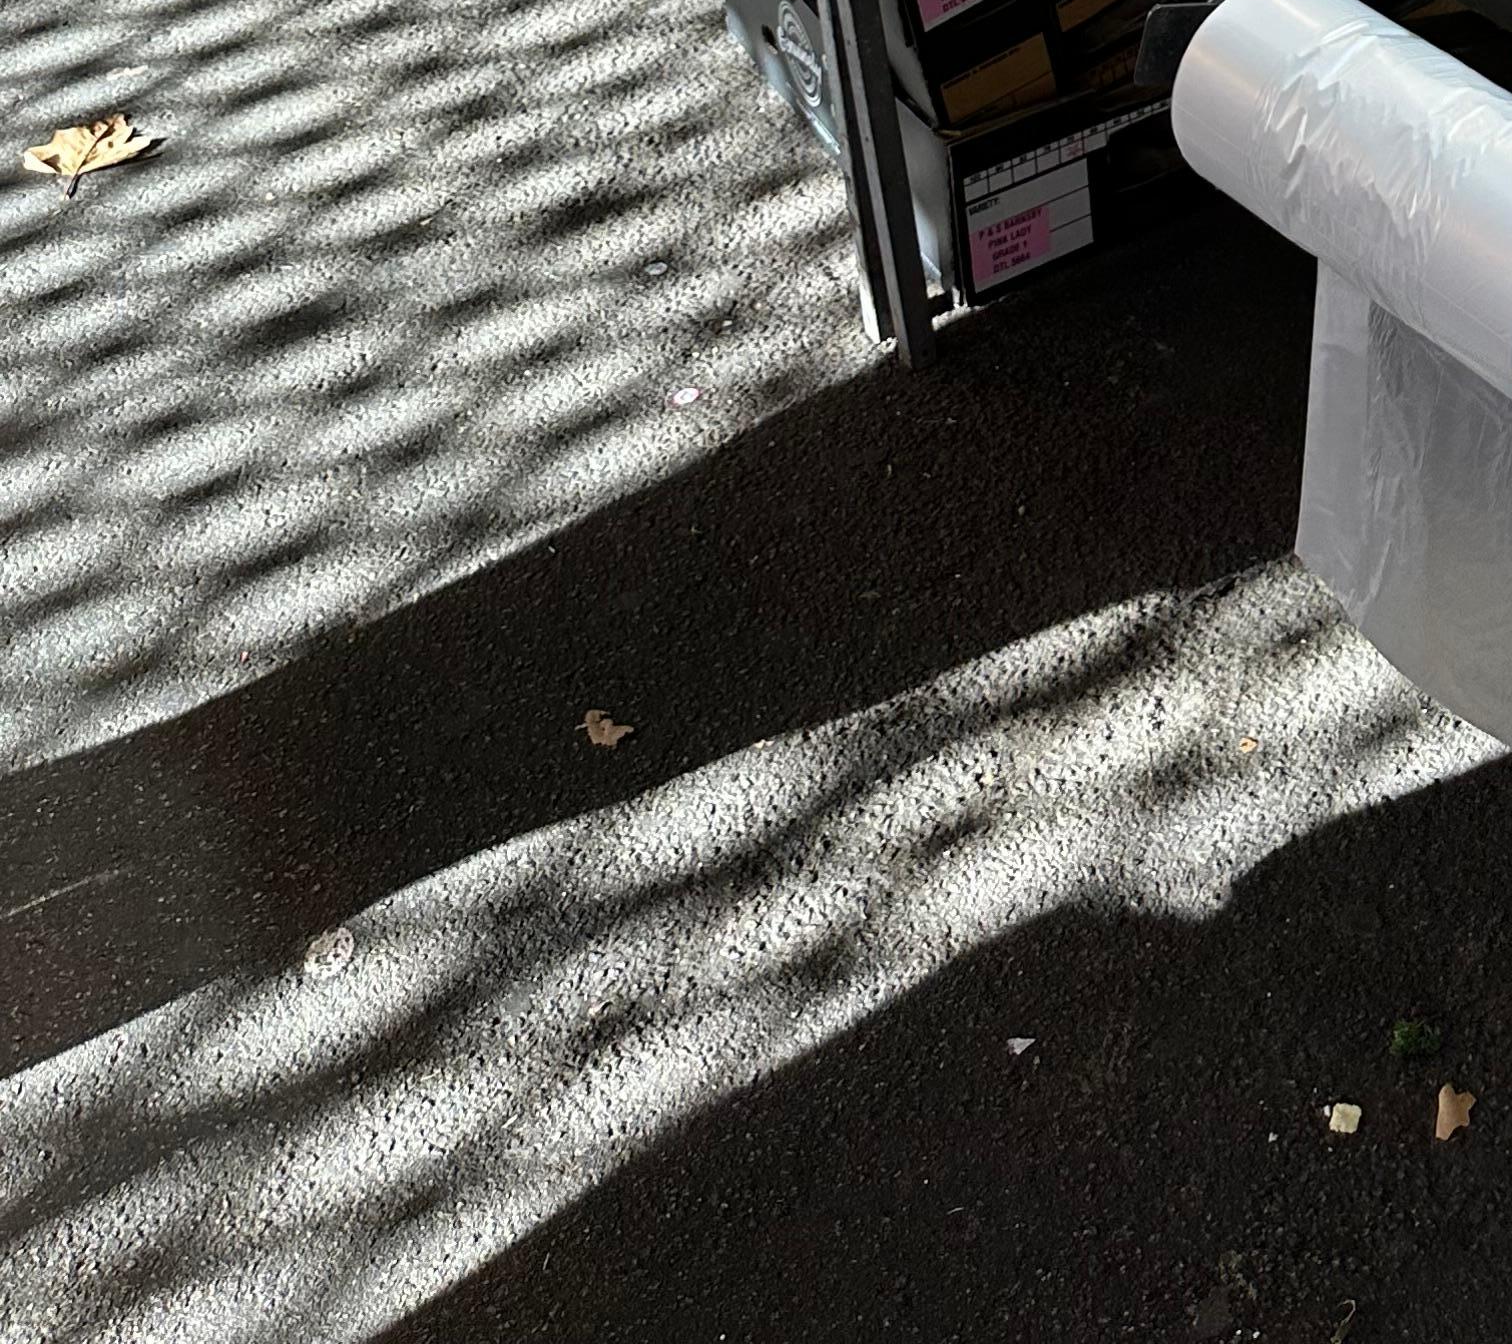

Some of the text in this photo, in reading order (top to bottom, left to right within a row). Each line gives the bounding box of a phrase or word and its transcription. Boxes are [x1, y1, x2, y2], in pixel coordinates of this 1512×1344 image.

[987, 224, 1033, 250] PINK LADY
[992, 242, 1020, 262] GRADE
